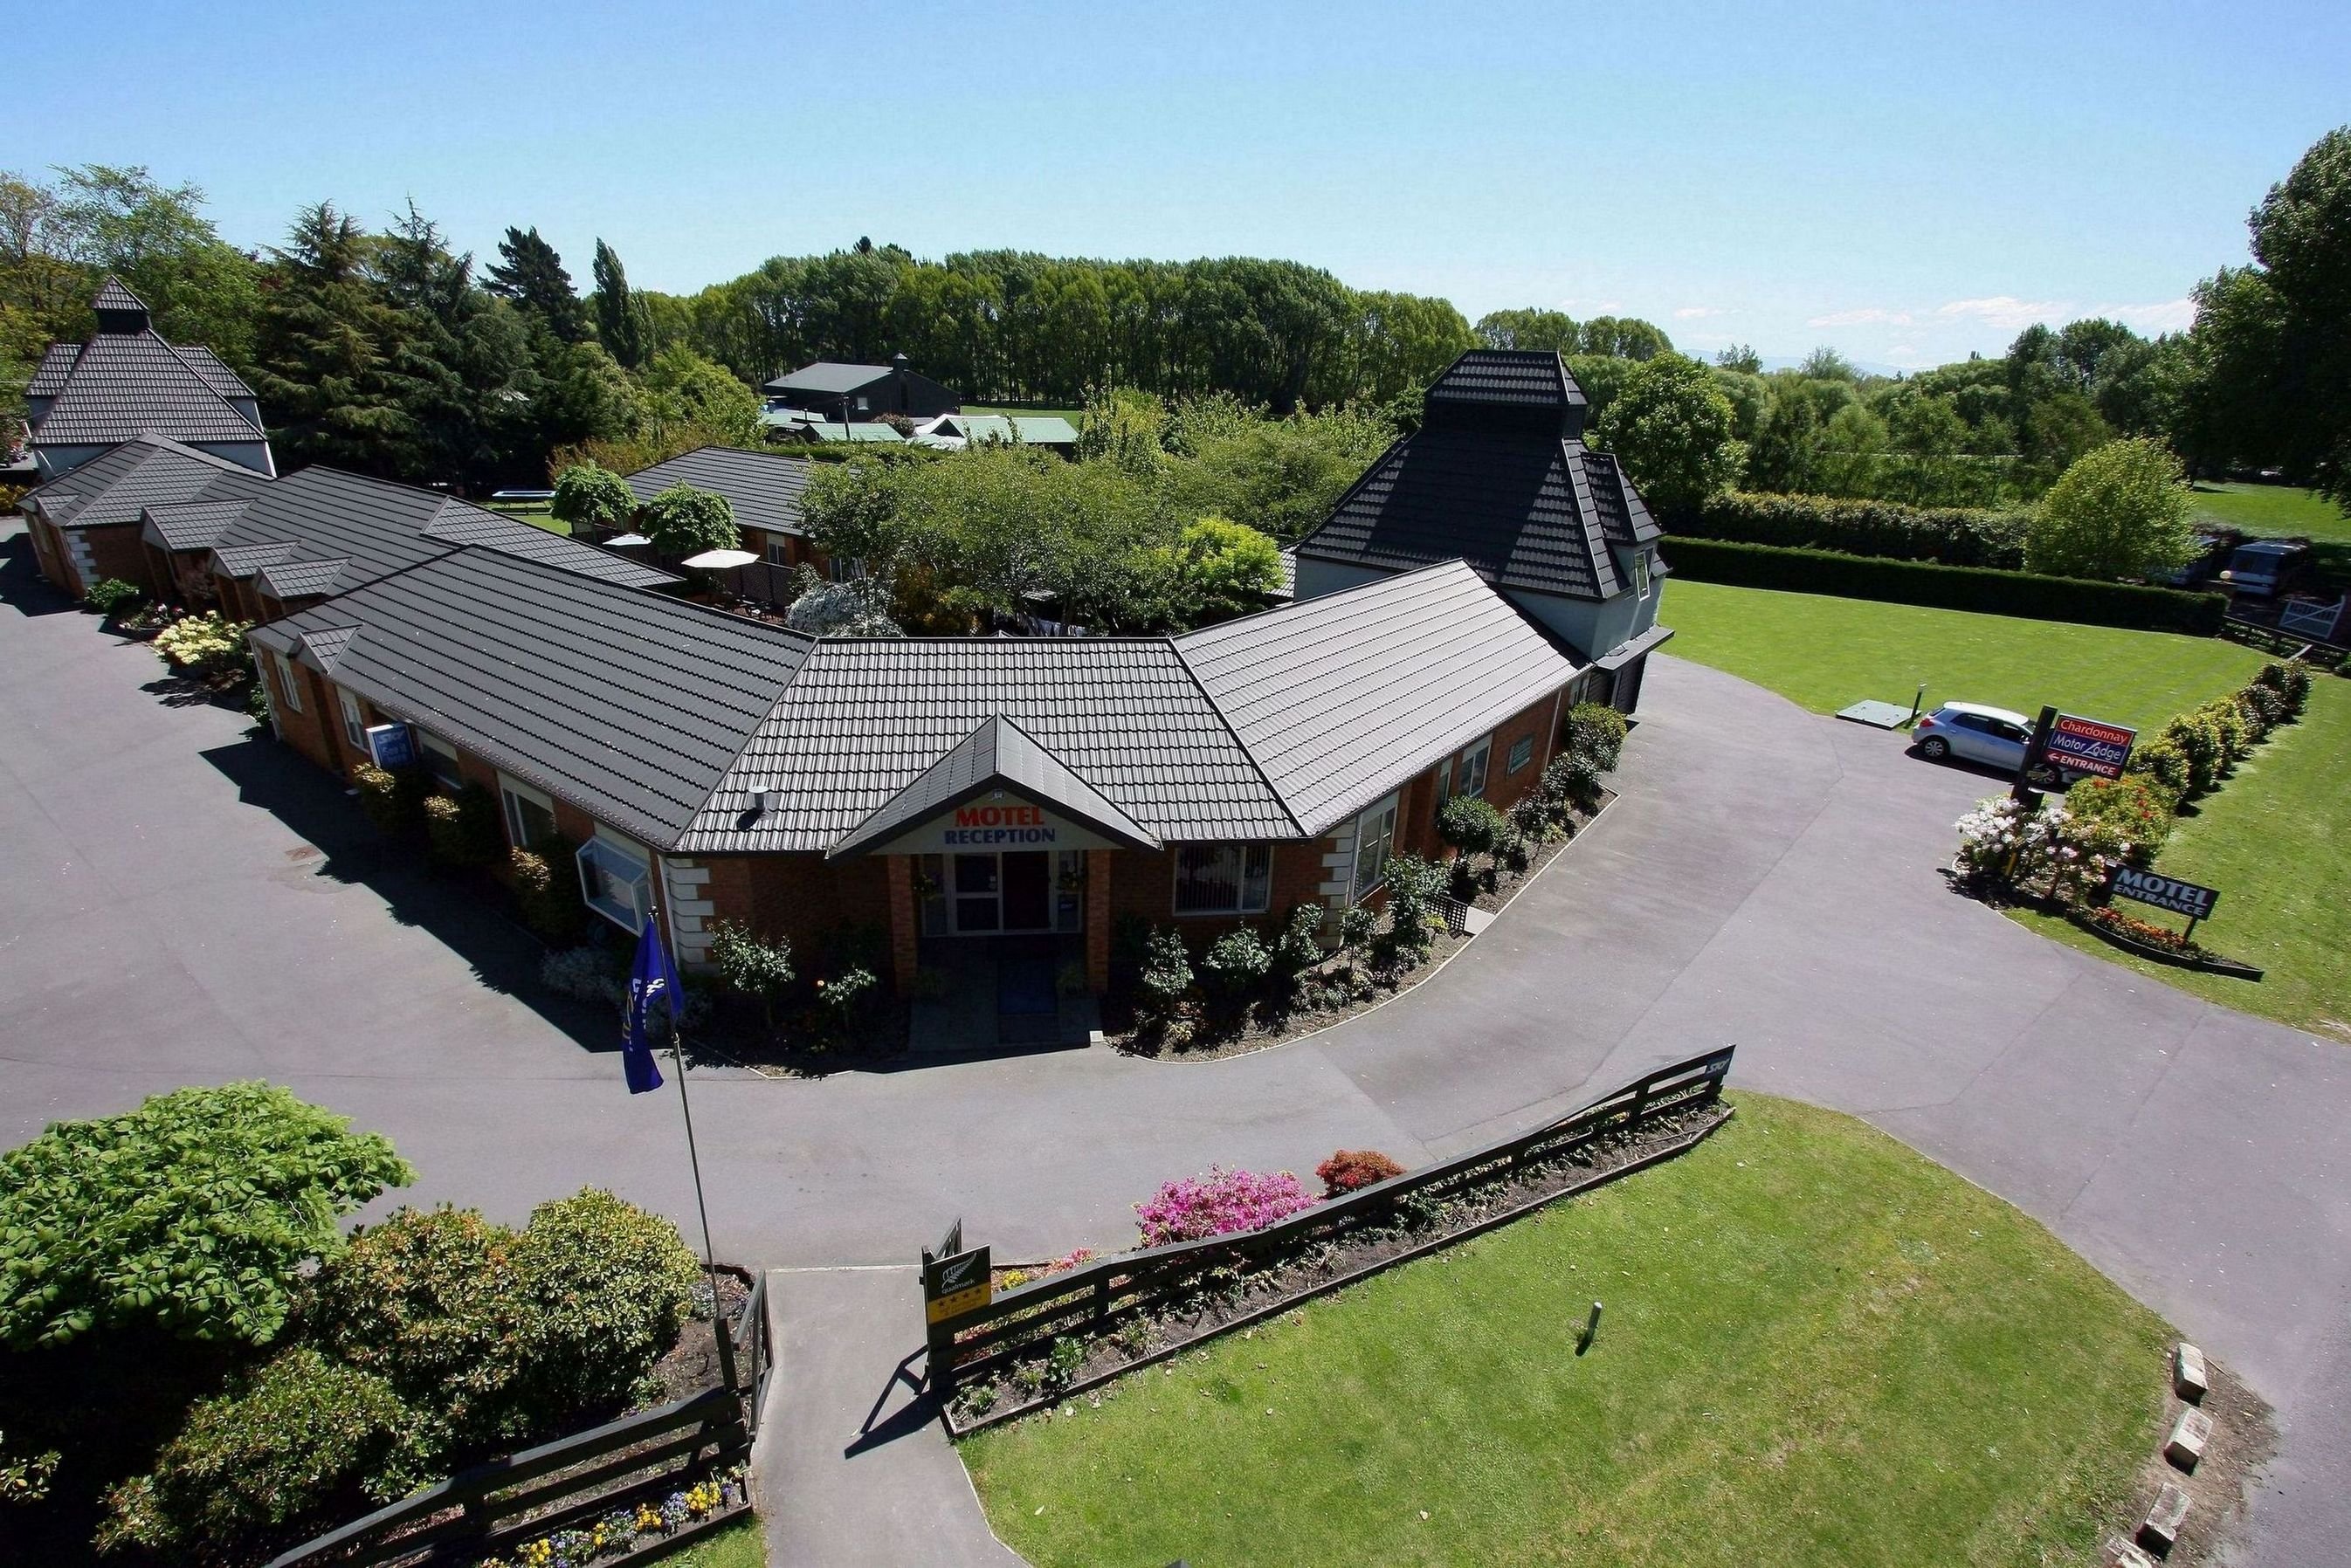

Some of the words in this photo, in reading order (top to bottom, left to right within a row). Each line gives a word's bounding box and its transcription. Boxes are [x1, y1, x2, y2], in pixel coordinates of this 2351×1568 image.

[2061, 719, 2127, 745] Chardonnay
[2053, 734, 2087, 751] Motor
[2081, 741, 2120, 760] Lodge
[2059, 755, 2115, 776] ENTRANCE
[955, 806, 1045, 827] MOTEL
[944, 829, 1056, 844] RECEPTION
[2116, 869, 2208, 906] MOTEL
[2113, 884, 2204, 916] ENTRANCE
[941, 1277, 976, 1294] qualmark
